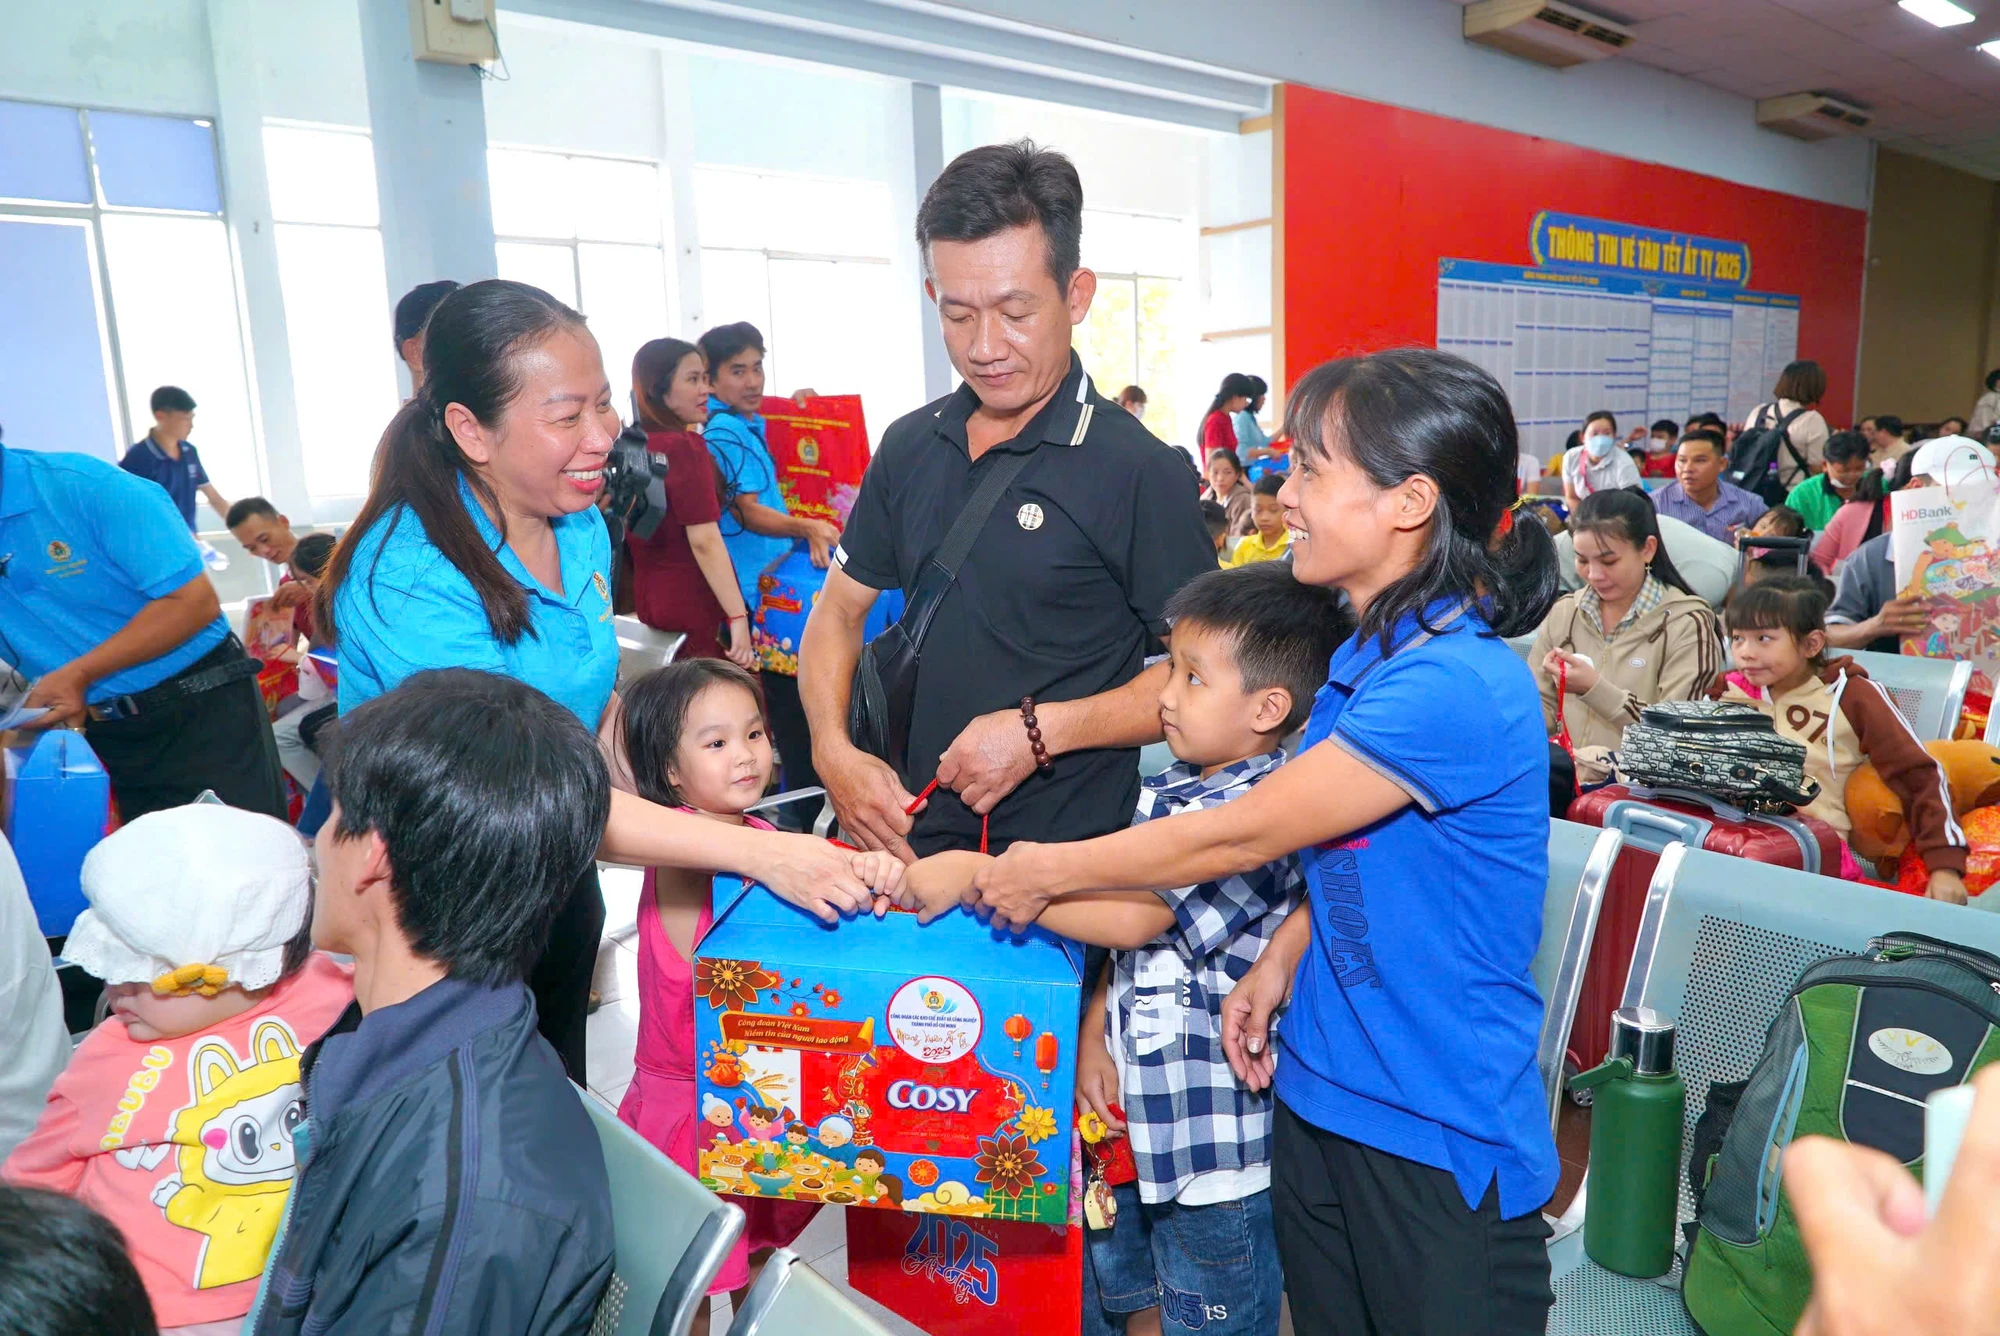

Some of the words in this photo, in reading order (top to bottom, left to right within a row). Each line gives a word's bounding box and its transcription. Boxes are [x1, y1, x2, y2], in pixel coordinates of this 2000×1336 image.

[1548, 224, 1594, 263] THÔNG
[1598, 233, 1618, 265] TIN
[1621, 234, 1635, 268] VÉ
[1638, 236, 1660, 271] TÀU
[1663, 236, 1682, 273] TẾT
[1715, 252, 1741, 280] 2025
[1901, 506, 1953, 520] HDBank
[1786, 704, 1830, 744] 97
[738, 1020, 756, 1028] Công
[757, 1019, 776, 1027] đoàn
[777, 1020, 792, 1029] Việt
[792, 1024, 810, 1032] Nam
[815, 1036, 828, 1044] lao
[922, 1045, 952, 1058] 2025
[886, 1079, 980, 1114] COSY
[974, 1221, 999, 1240] YEAR
[904, 1208, 999, 1306] 2025
